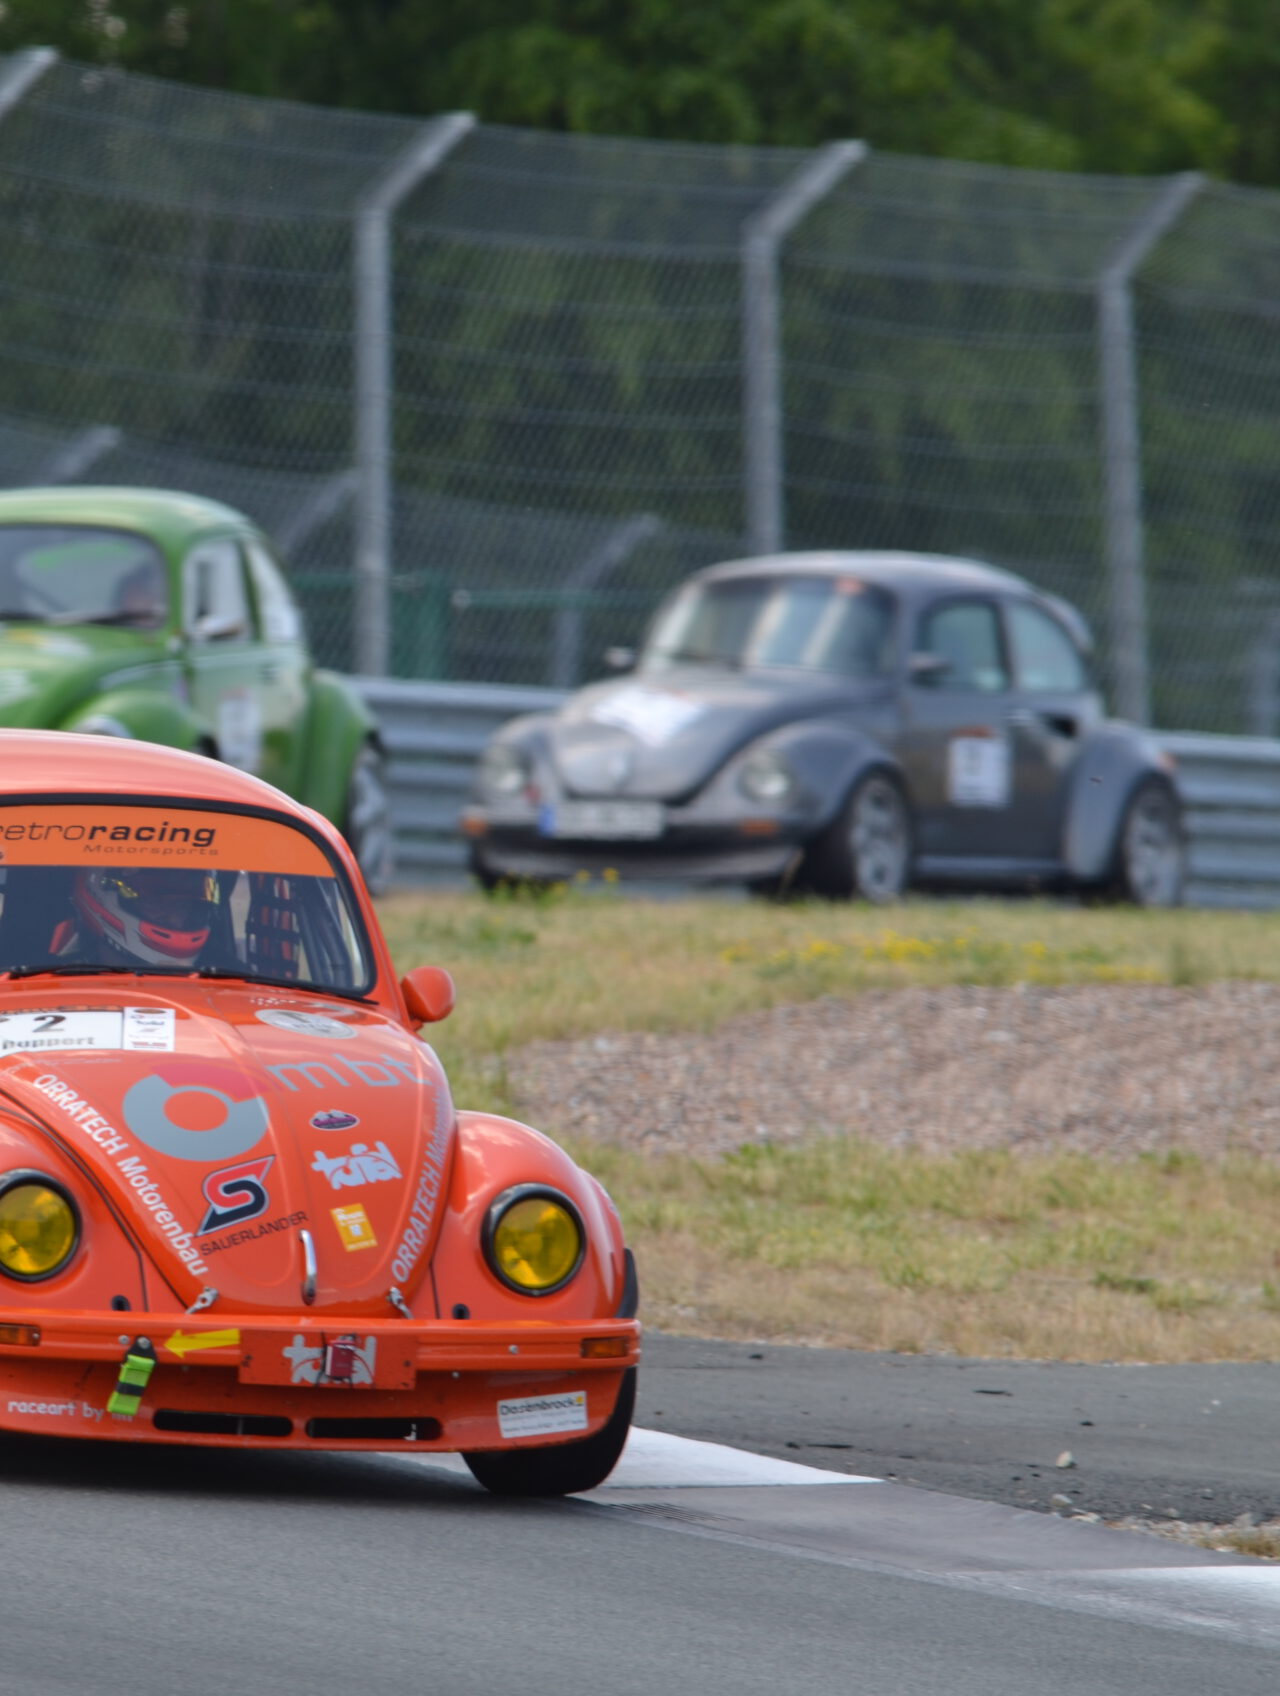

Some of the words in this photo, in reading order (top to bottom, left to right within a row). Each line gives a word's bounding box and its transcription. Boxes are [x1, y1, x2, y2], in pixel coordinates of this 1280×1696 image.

[83, 843, 219, 856] Motorsports
[32, 1014, 67, 1033] 2
[116, 1156, 209, 1277] Motorenbau
[7, 1400, 76, 1417] raceart
[82, 1402, 105, 1423] by
